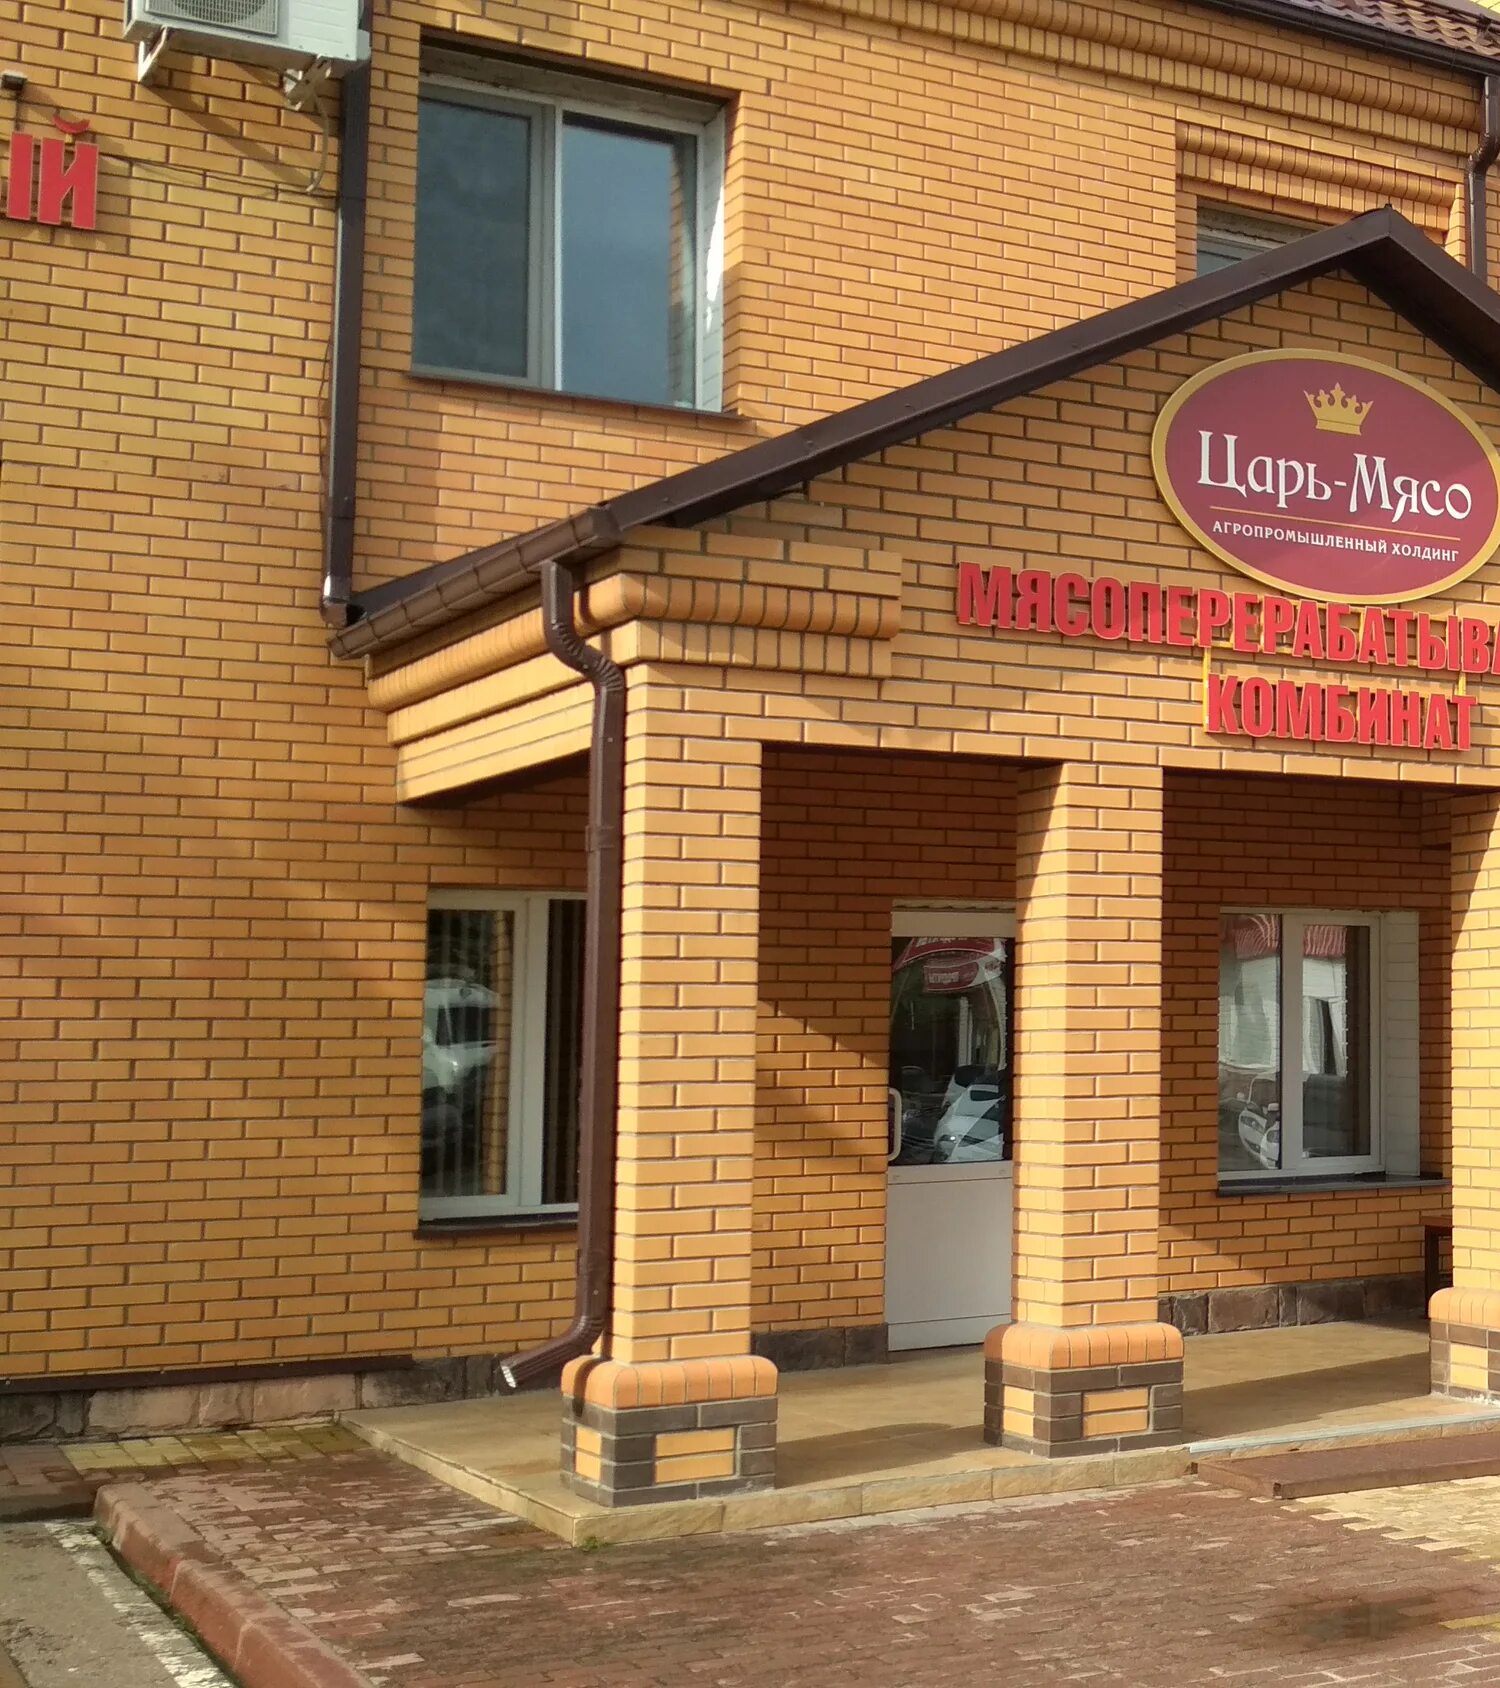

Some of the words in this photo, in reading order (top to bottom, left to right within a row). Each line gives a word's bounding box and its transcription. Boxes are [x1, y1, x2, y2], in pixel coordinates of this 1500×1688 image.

[1197, 430, 1473, 521] Царь-Мясо
[1212, 519, 1388, 554] АГРОПРОМЫШЛЕННЫЙ
[1391, 541, 1460, 563] ХОЛДИНГ
[1207, 672, 1478, 752] КОМБИНАТ
